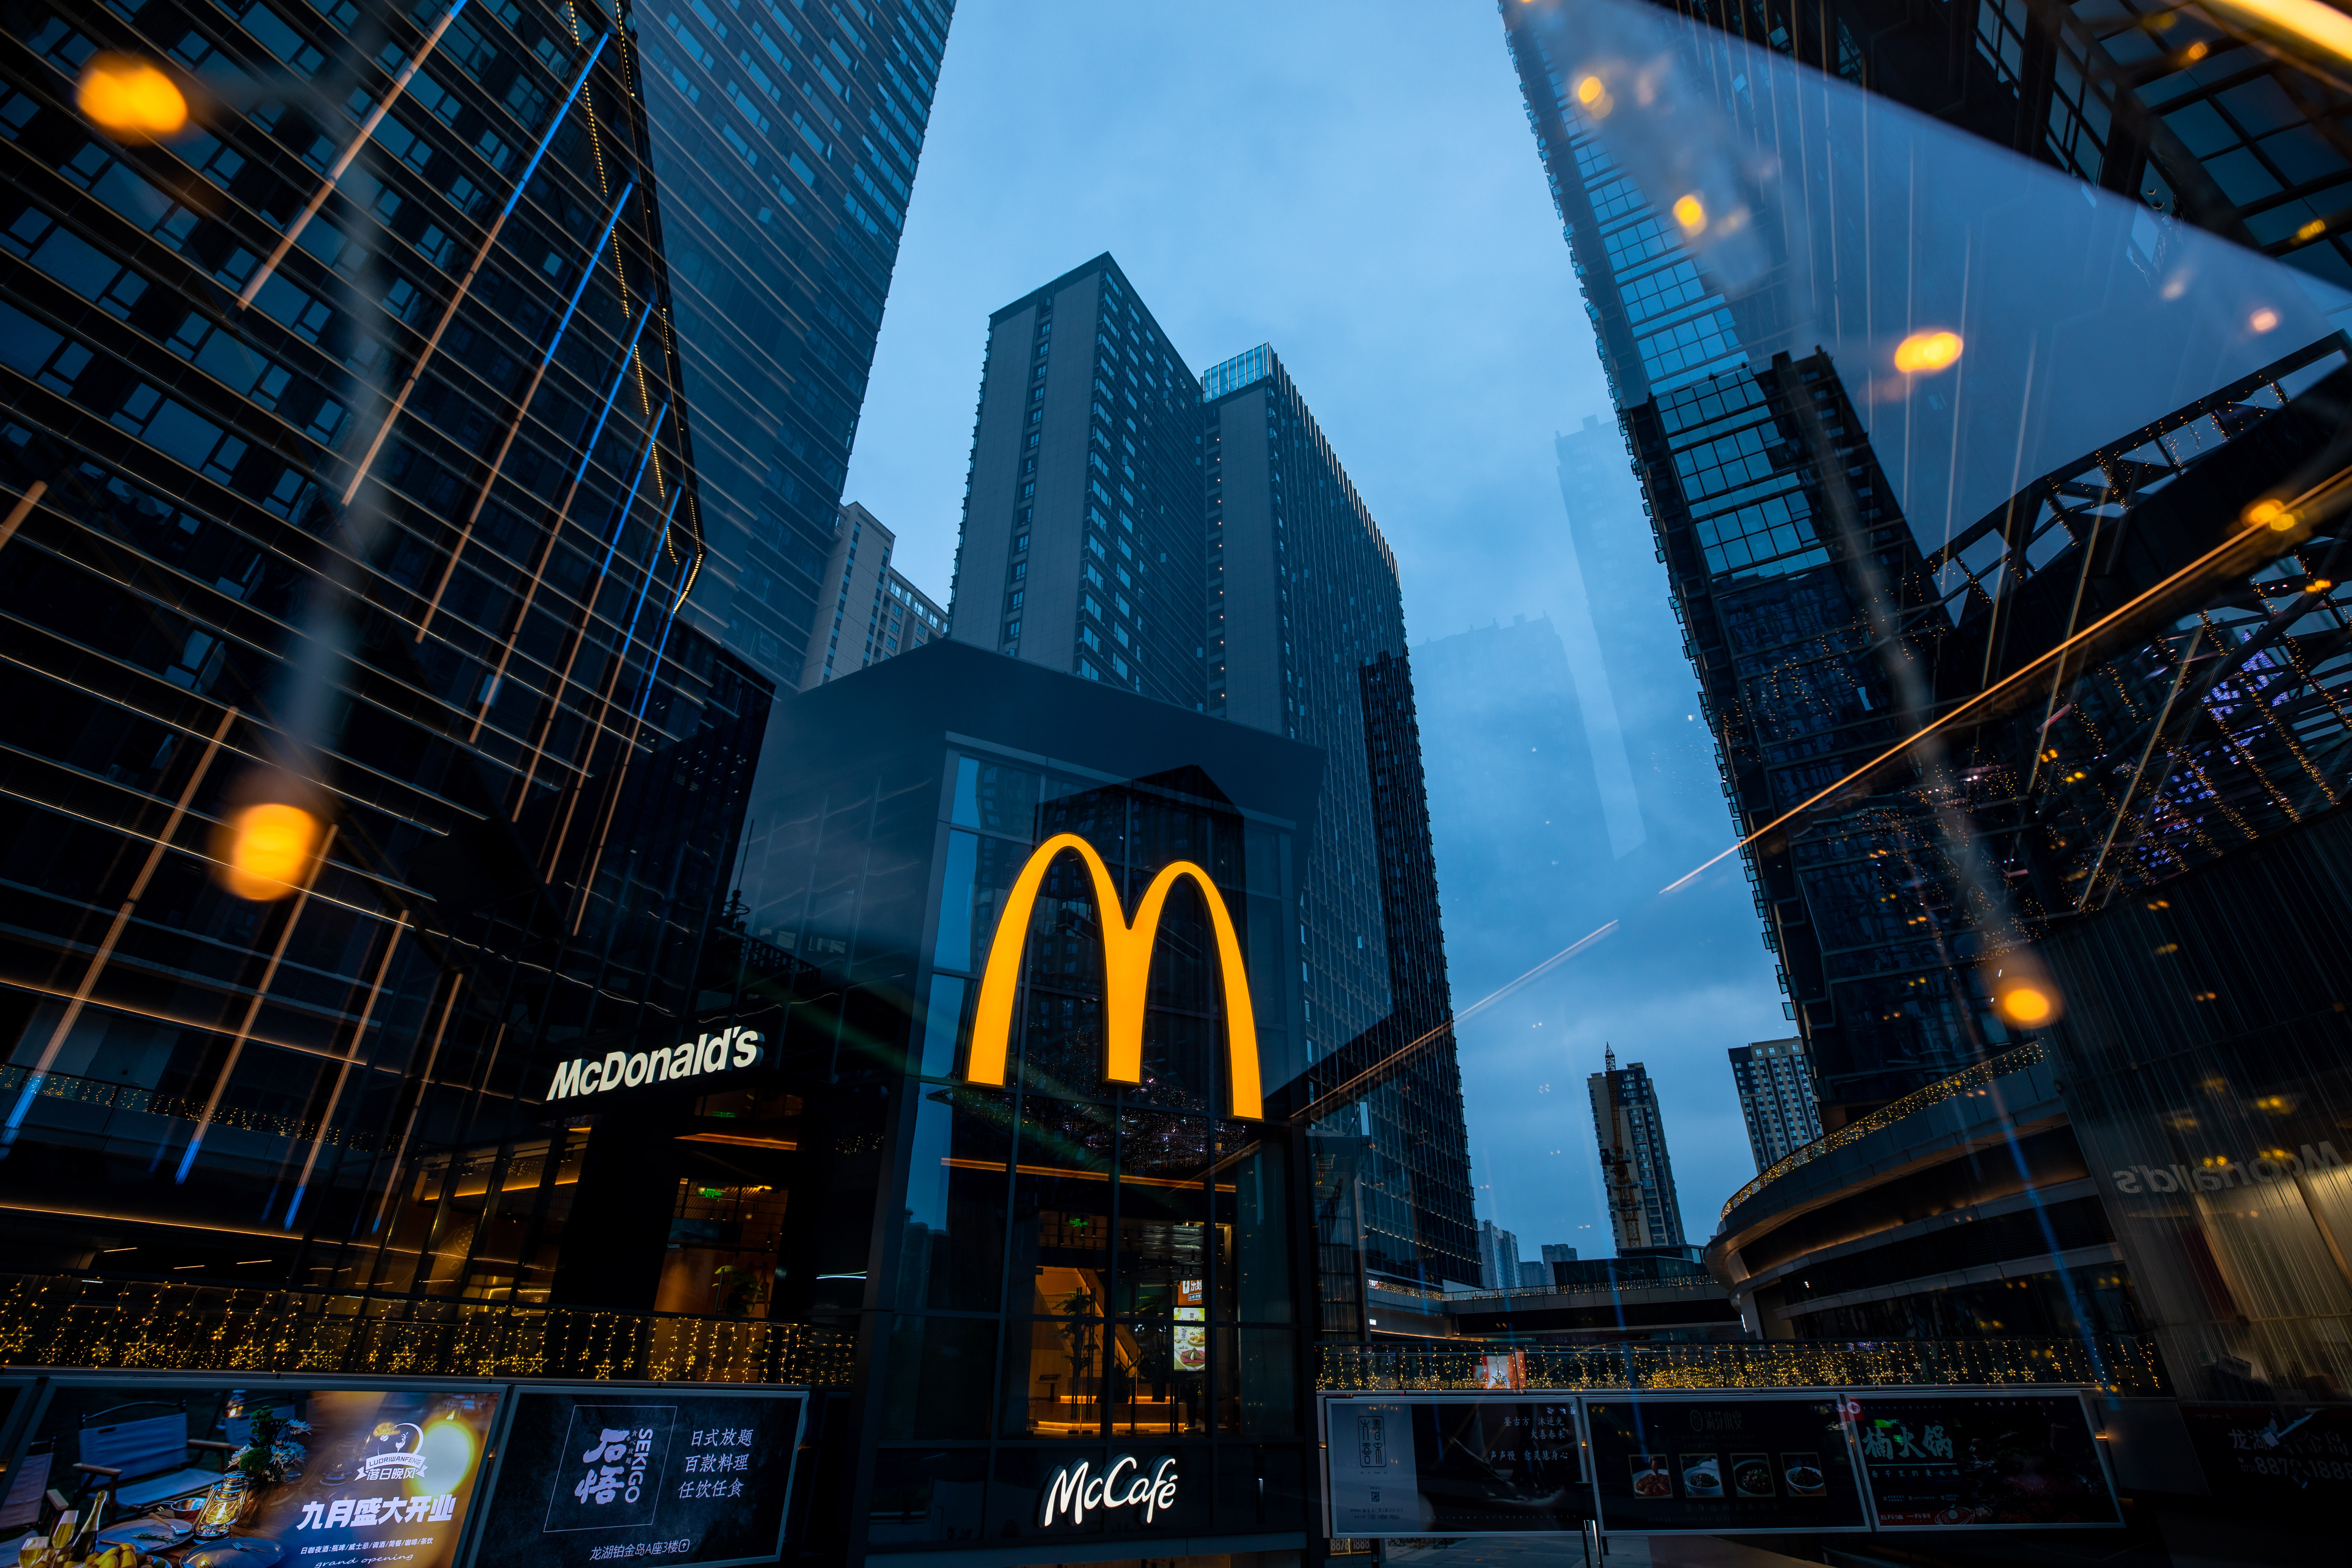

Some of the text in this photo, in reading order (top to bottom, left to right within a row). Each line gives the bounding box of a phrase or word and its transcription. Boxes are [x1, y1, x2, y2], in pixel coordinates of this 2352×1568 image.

[546, 1026, 764, 1101] McDonald's
[1504, 1416, 1564, 1426] 鉴古方 沐逆光
[691, 1428, 754, 1447] 日式放题
[1530, 1429, 1566, 1439] 大喜春来
[1862, 1425, 1953, 1460] 楠火锅
[369, 1456, 422, 1466] LUORIWANFENG
[685, 1454, 749, 1473] 百款料理
[1490, 1450, 1568, 1461] 声声慢 愈灵慧身心
[366, 1467, 415, 1480] 落日晚风
[625, 1428, 653, 1503] SEKIGO
[1872, 1469, 1959, 1478] 巷子里的老火锅
[678, 1478, 744, 1499] 任饮任食
[1044, 1457, 1178, 1527] McCafé
[296, 1494, 457, 1530] 九月盛大开业
[590, 1540, 679, 1560] 龙湖铂金岛A座3楼
[314, 1553, 413, 1568] grand opening
